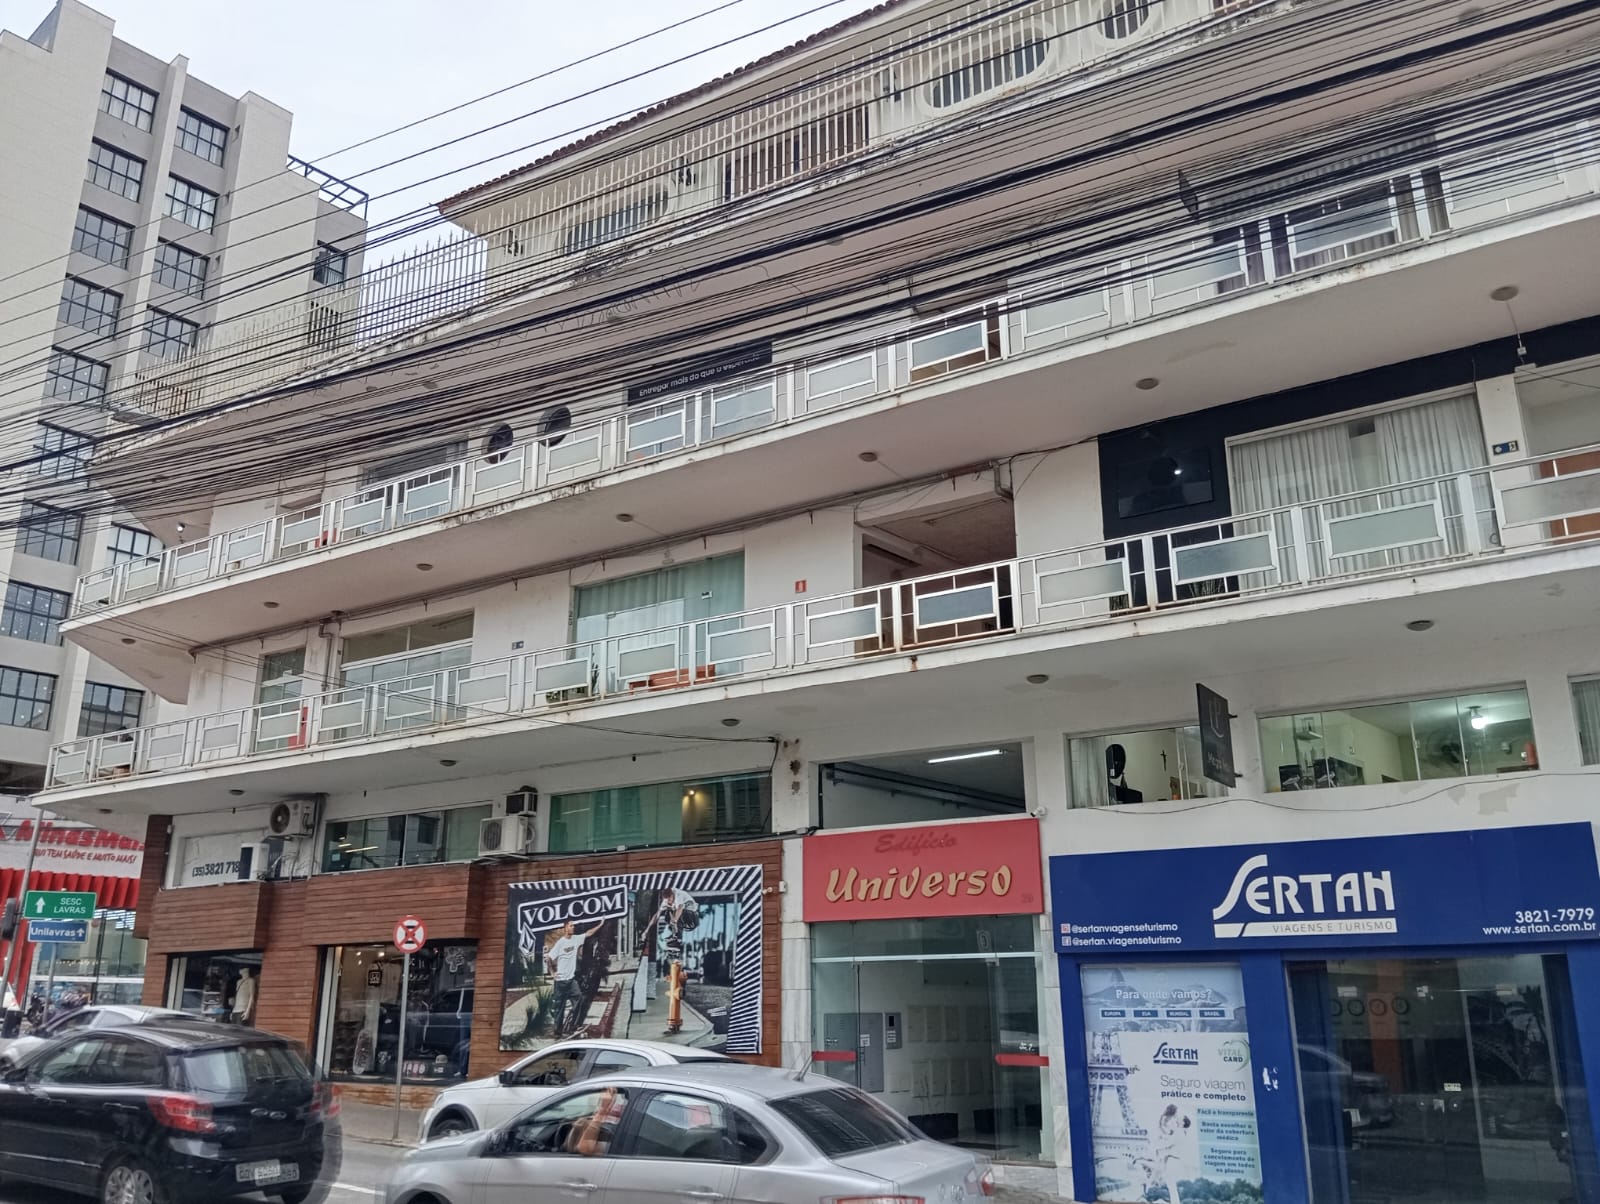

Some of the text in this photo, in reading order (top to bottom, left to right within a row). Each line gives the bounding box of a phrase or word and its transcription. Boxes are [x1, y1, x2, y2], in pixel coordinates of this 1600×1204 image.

[639, 382, 669, 397] Entregar
[670, 376, 689, 387] mais
[689, 372, 700, 381] do
[700, 369, 715, 378] que
[47, 849, 63, 858] TEM
[93, 853, 115, 861] MUITO
[825, 865, 1013, 903] Universo
[1212, 853, 1396, 921] SERTAN
[60, 897, 82, 906] SESC
[53, 906, 86, 914] LAVRAS
[522, 892, 624, 925] VOLCOM
[1515, 907, 1595, 924] 3821-7979
[30, 927, 77, 937] Unilavras
[1272, 920, 1393, 933] VIAGENS E TURISMO
[1482, 921, 1596, 935] www.sertan.com.br
[1071, 936, 1182, 947] @sertan.viagenseturismo
[1115, 988, 1212, 999] Para onde vamos?
[1153, 1042, 1198, 1060] SERTAN
[1160, 1074, 1246, 1092] Seguro viagem
[1161, 1090, 1193, 1099] prático
[1203, 1091, 1246, 1101] completo
